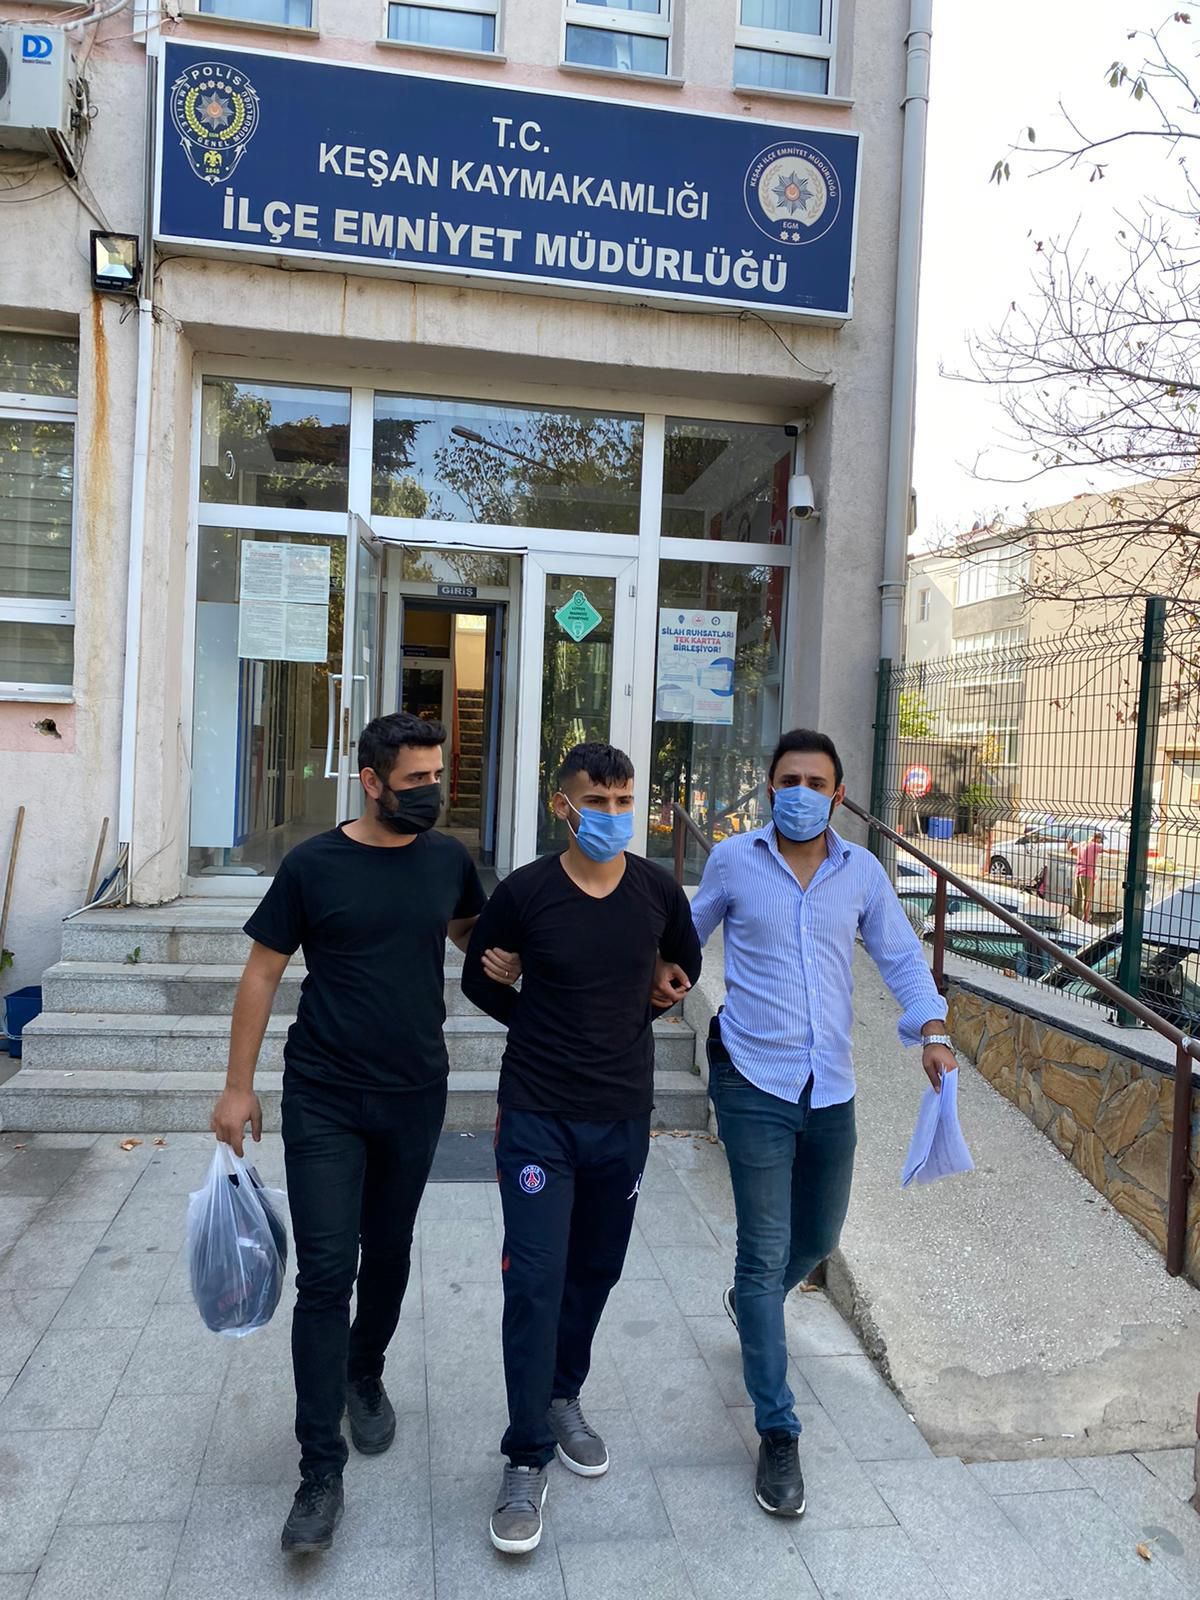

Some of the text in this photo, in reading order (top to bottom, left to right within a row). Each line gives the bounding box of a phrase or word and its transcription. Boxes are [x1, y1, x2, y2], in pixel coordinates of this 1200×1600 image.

[191, 66, 241, 86] POLİS
[491, 116, 551, 153] T.C.
[319, 142, 709, 221] KEŞAN KAYMAKAMLIĞI
[222, 187, 788, 293] İLÇE EMNİYET MÜDÜRLÜĞÜ
[662, 627, 734, 638] SİLAH RUHSATLARI
[675, 636, 721, 645] TEK KARTTA
[673, 644, 721, 653] BİRLEŞİYOR!
